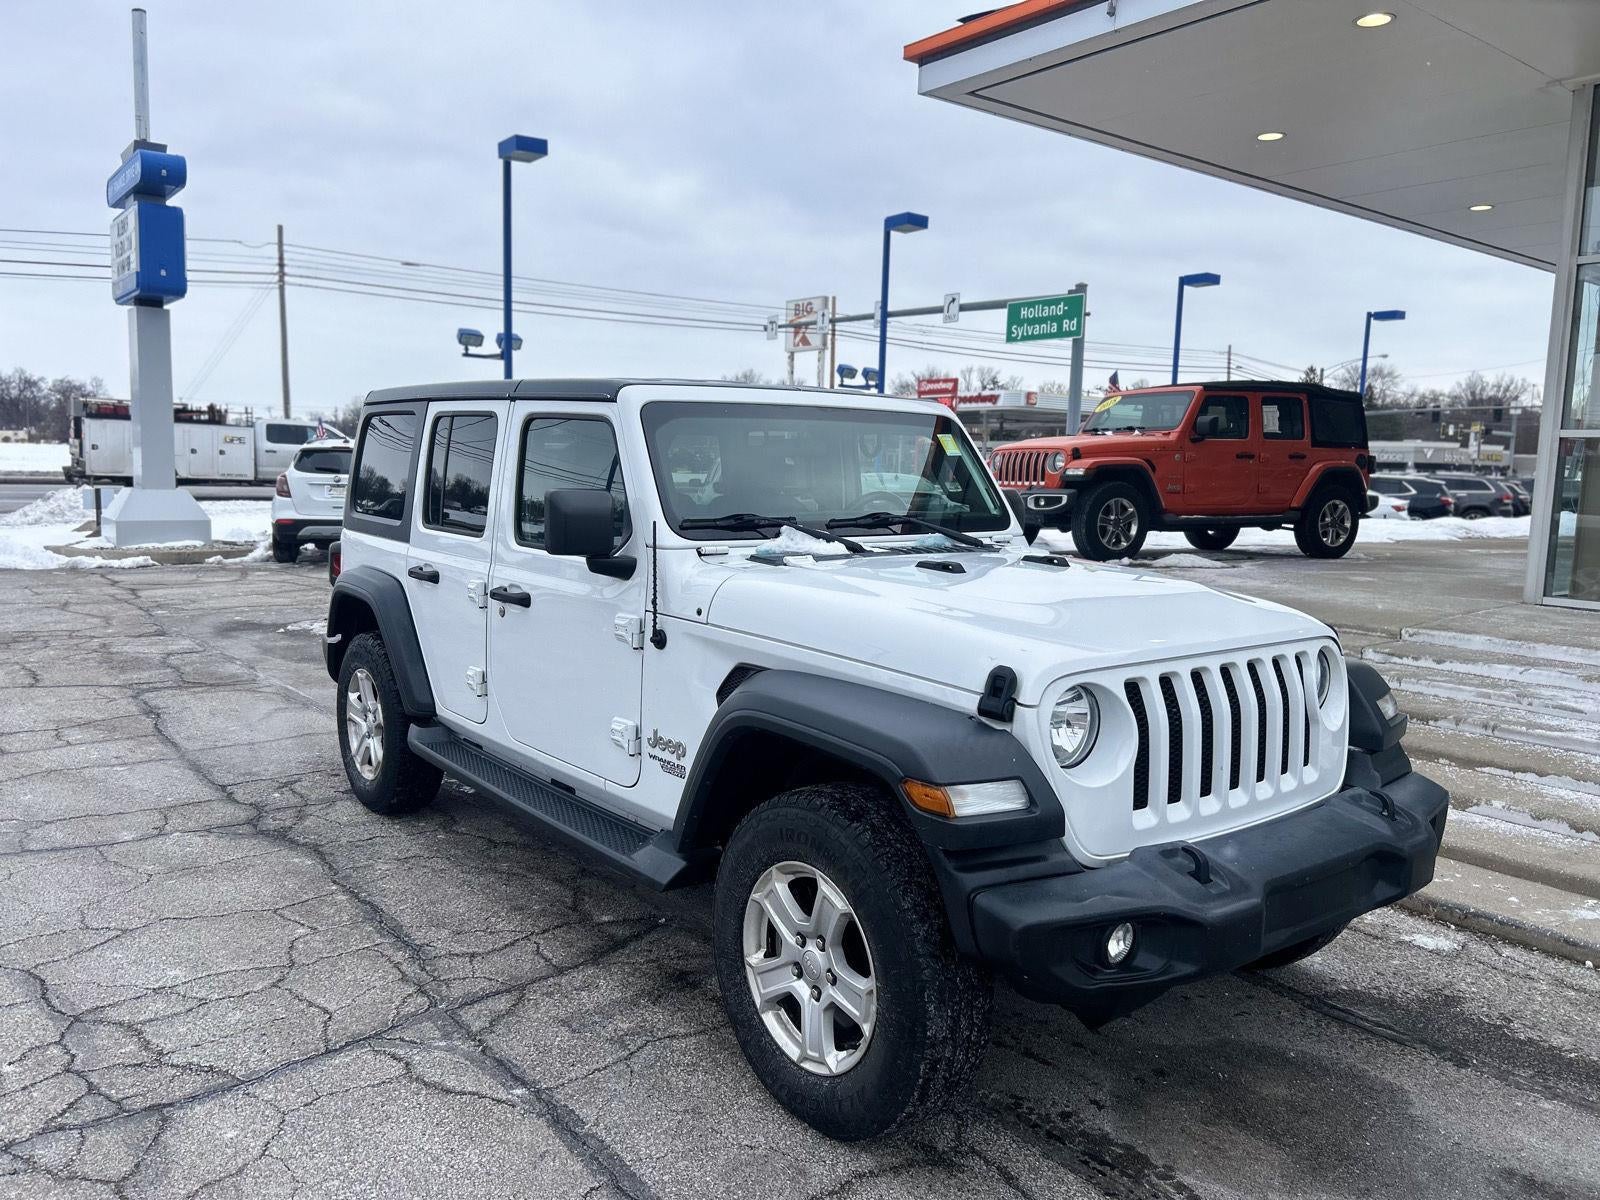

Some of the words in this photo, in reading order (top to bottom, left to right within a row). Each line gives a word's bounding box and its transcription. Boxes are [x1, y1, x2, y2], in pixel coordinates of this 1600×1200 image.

[794, 302, 814, 316] BIG
[1020, 301, 1068, 319] Holland-
[1011, 320, 1057, 339] Sylvania
[1062, 317, 1077, 332] Rd
[920, 381, 955, 394] Speedway
[957, 393, 1000, 406] peedway
[647, 728, 687, 761] Jeep
[648, 752, 686, 771] WRANGLER
